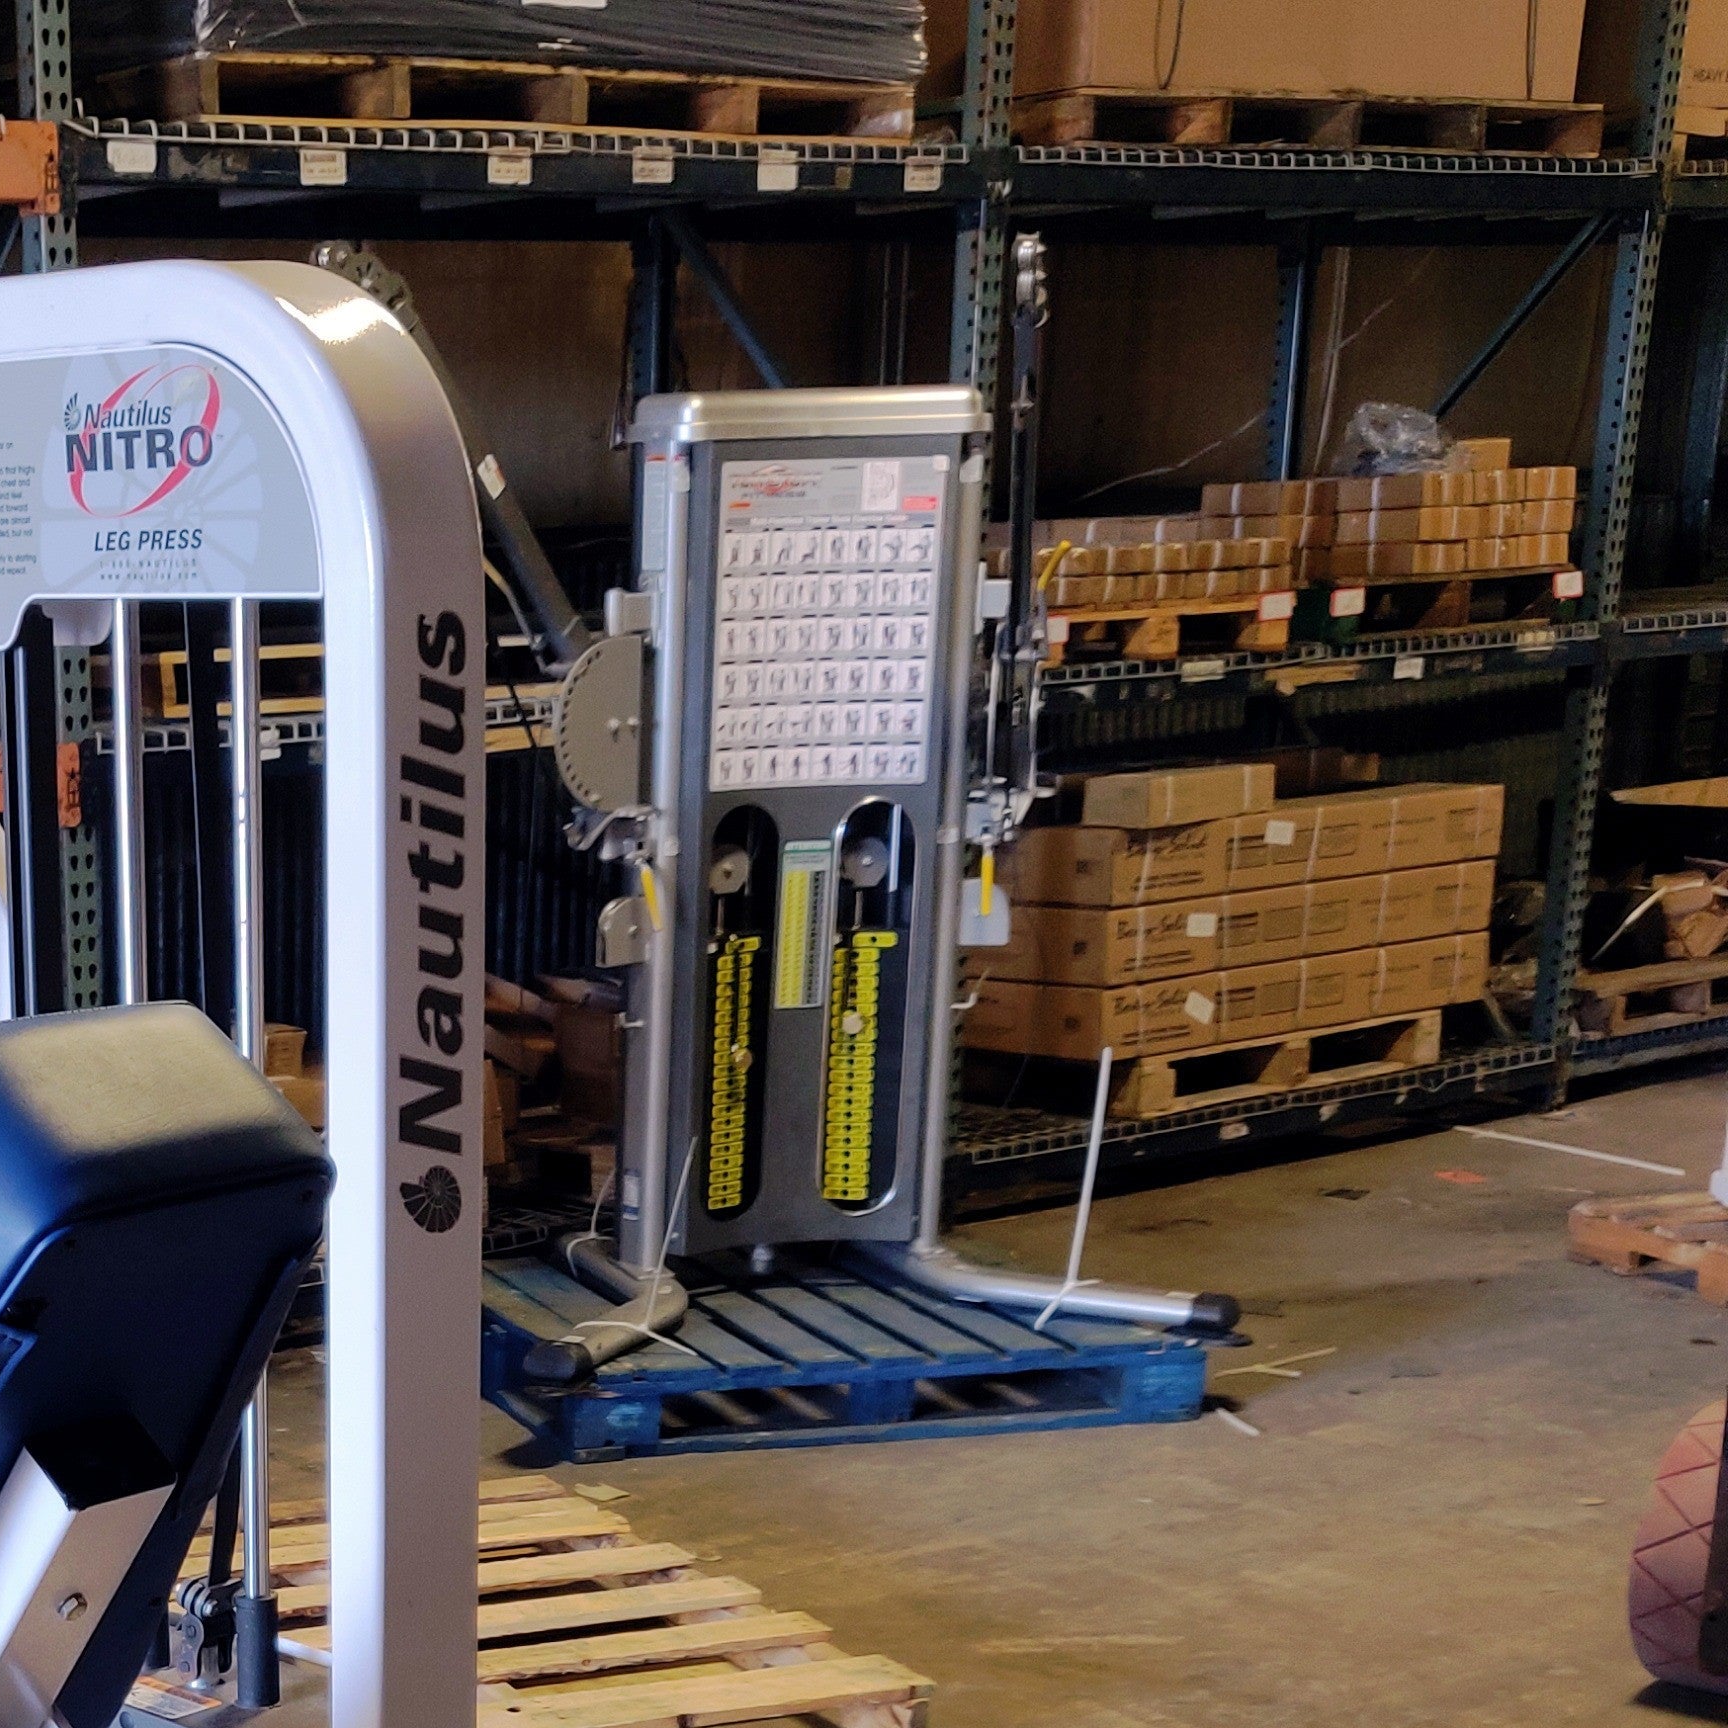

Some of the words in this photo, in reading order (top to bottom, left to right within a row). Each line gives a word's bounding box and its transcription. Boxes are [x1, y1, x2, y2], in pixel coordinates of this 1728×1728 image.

[84, 400, 172, 429] Nautilus
[65, 425, 213, 473] NITRO
[94, 530, 131, 552] LEG
[138, 528, 203, 551] PRESS
[398, 610, 467, 1156] Nautilus
